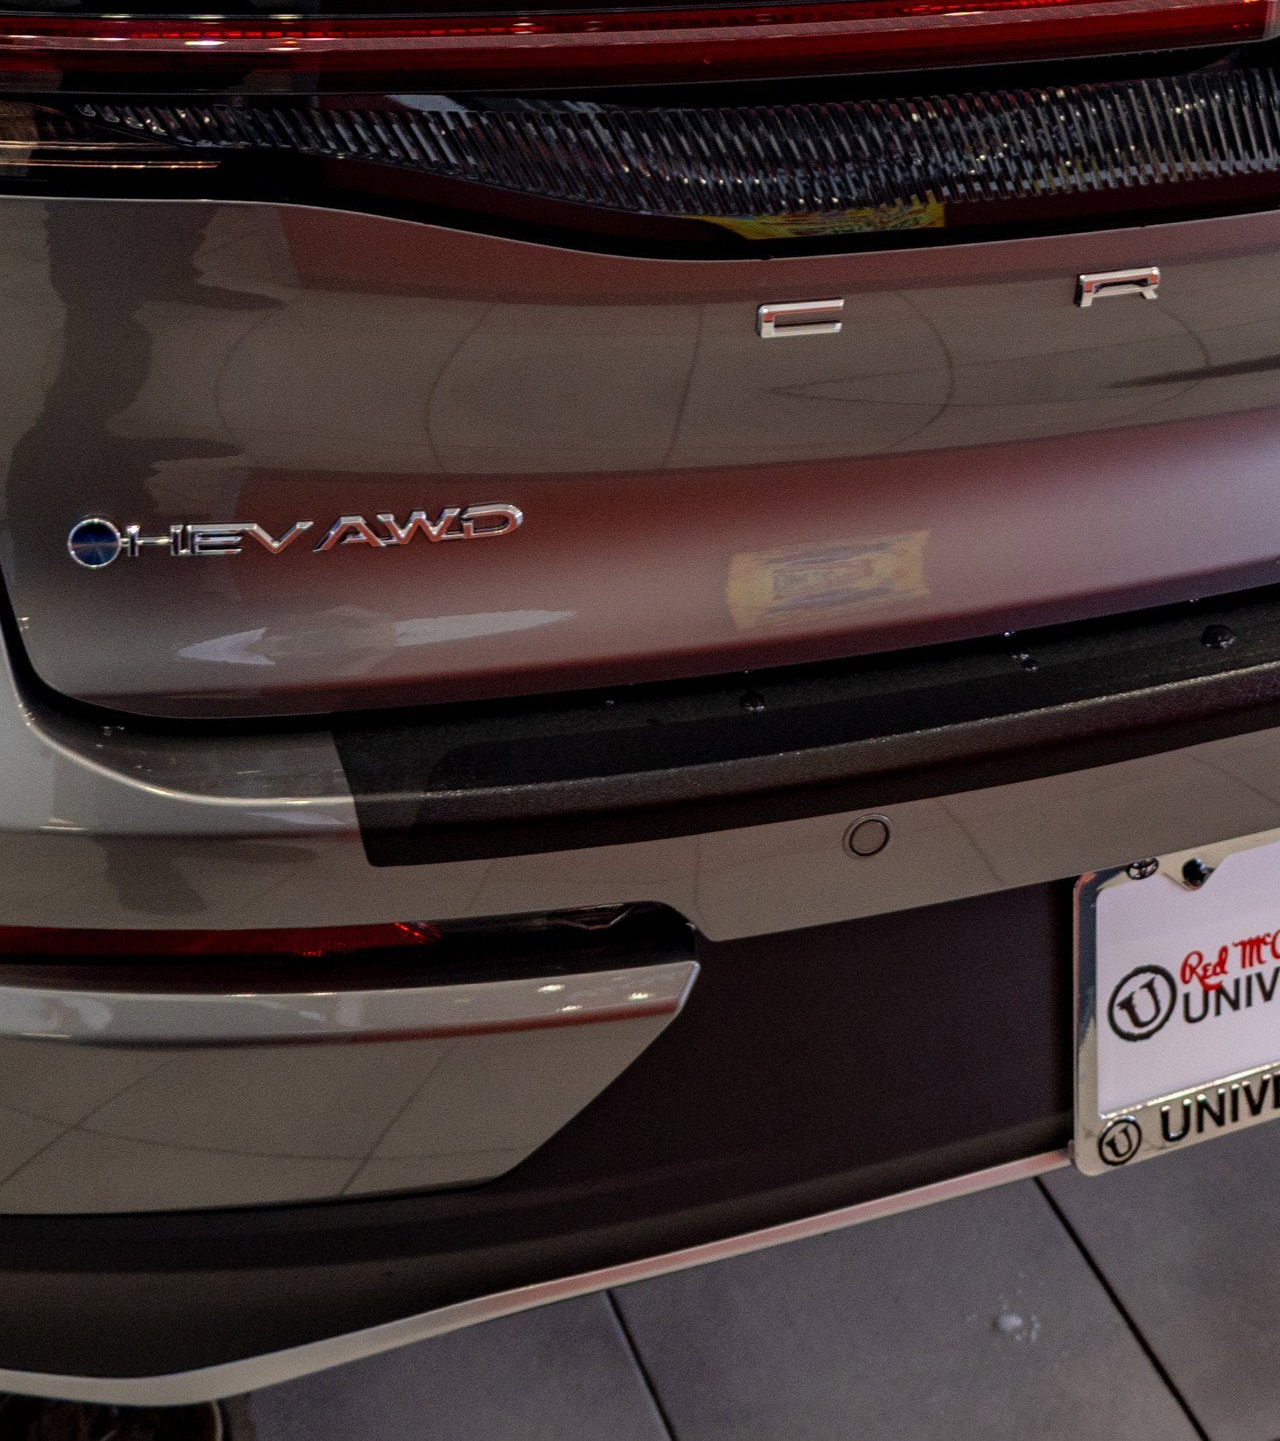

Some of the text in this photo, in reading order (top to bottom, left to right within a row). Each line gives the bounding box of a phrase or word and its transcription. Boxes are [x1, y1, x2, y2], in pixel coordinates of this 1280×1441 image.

[124, 502, 524, 557] HEV AWD
[1180, 945, 1228, 991] Red
